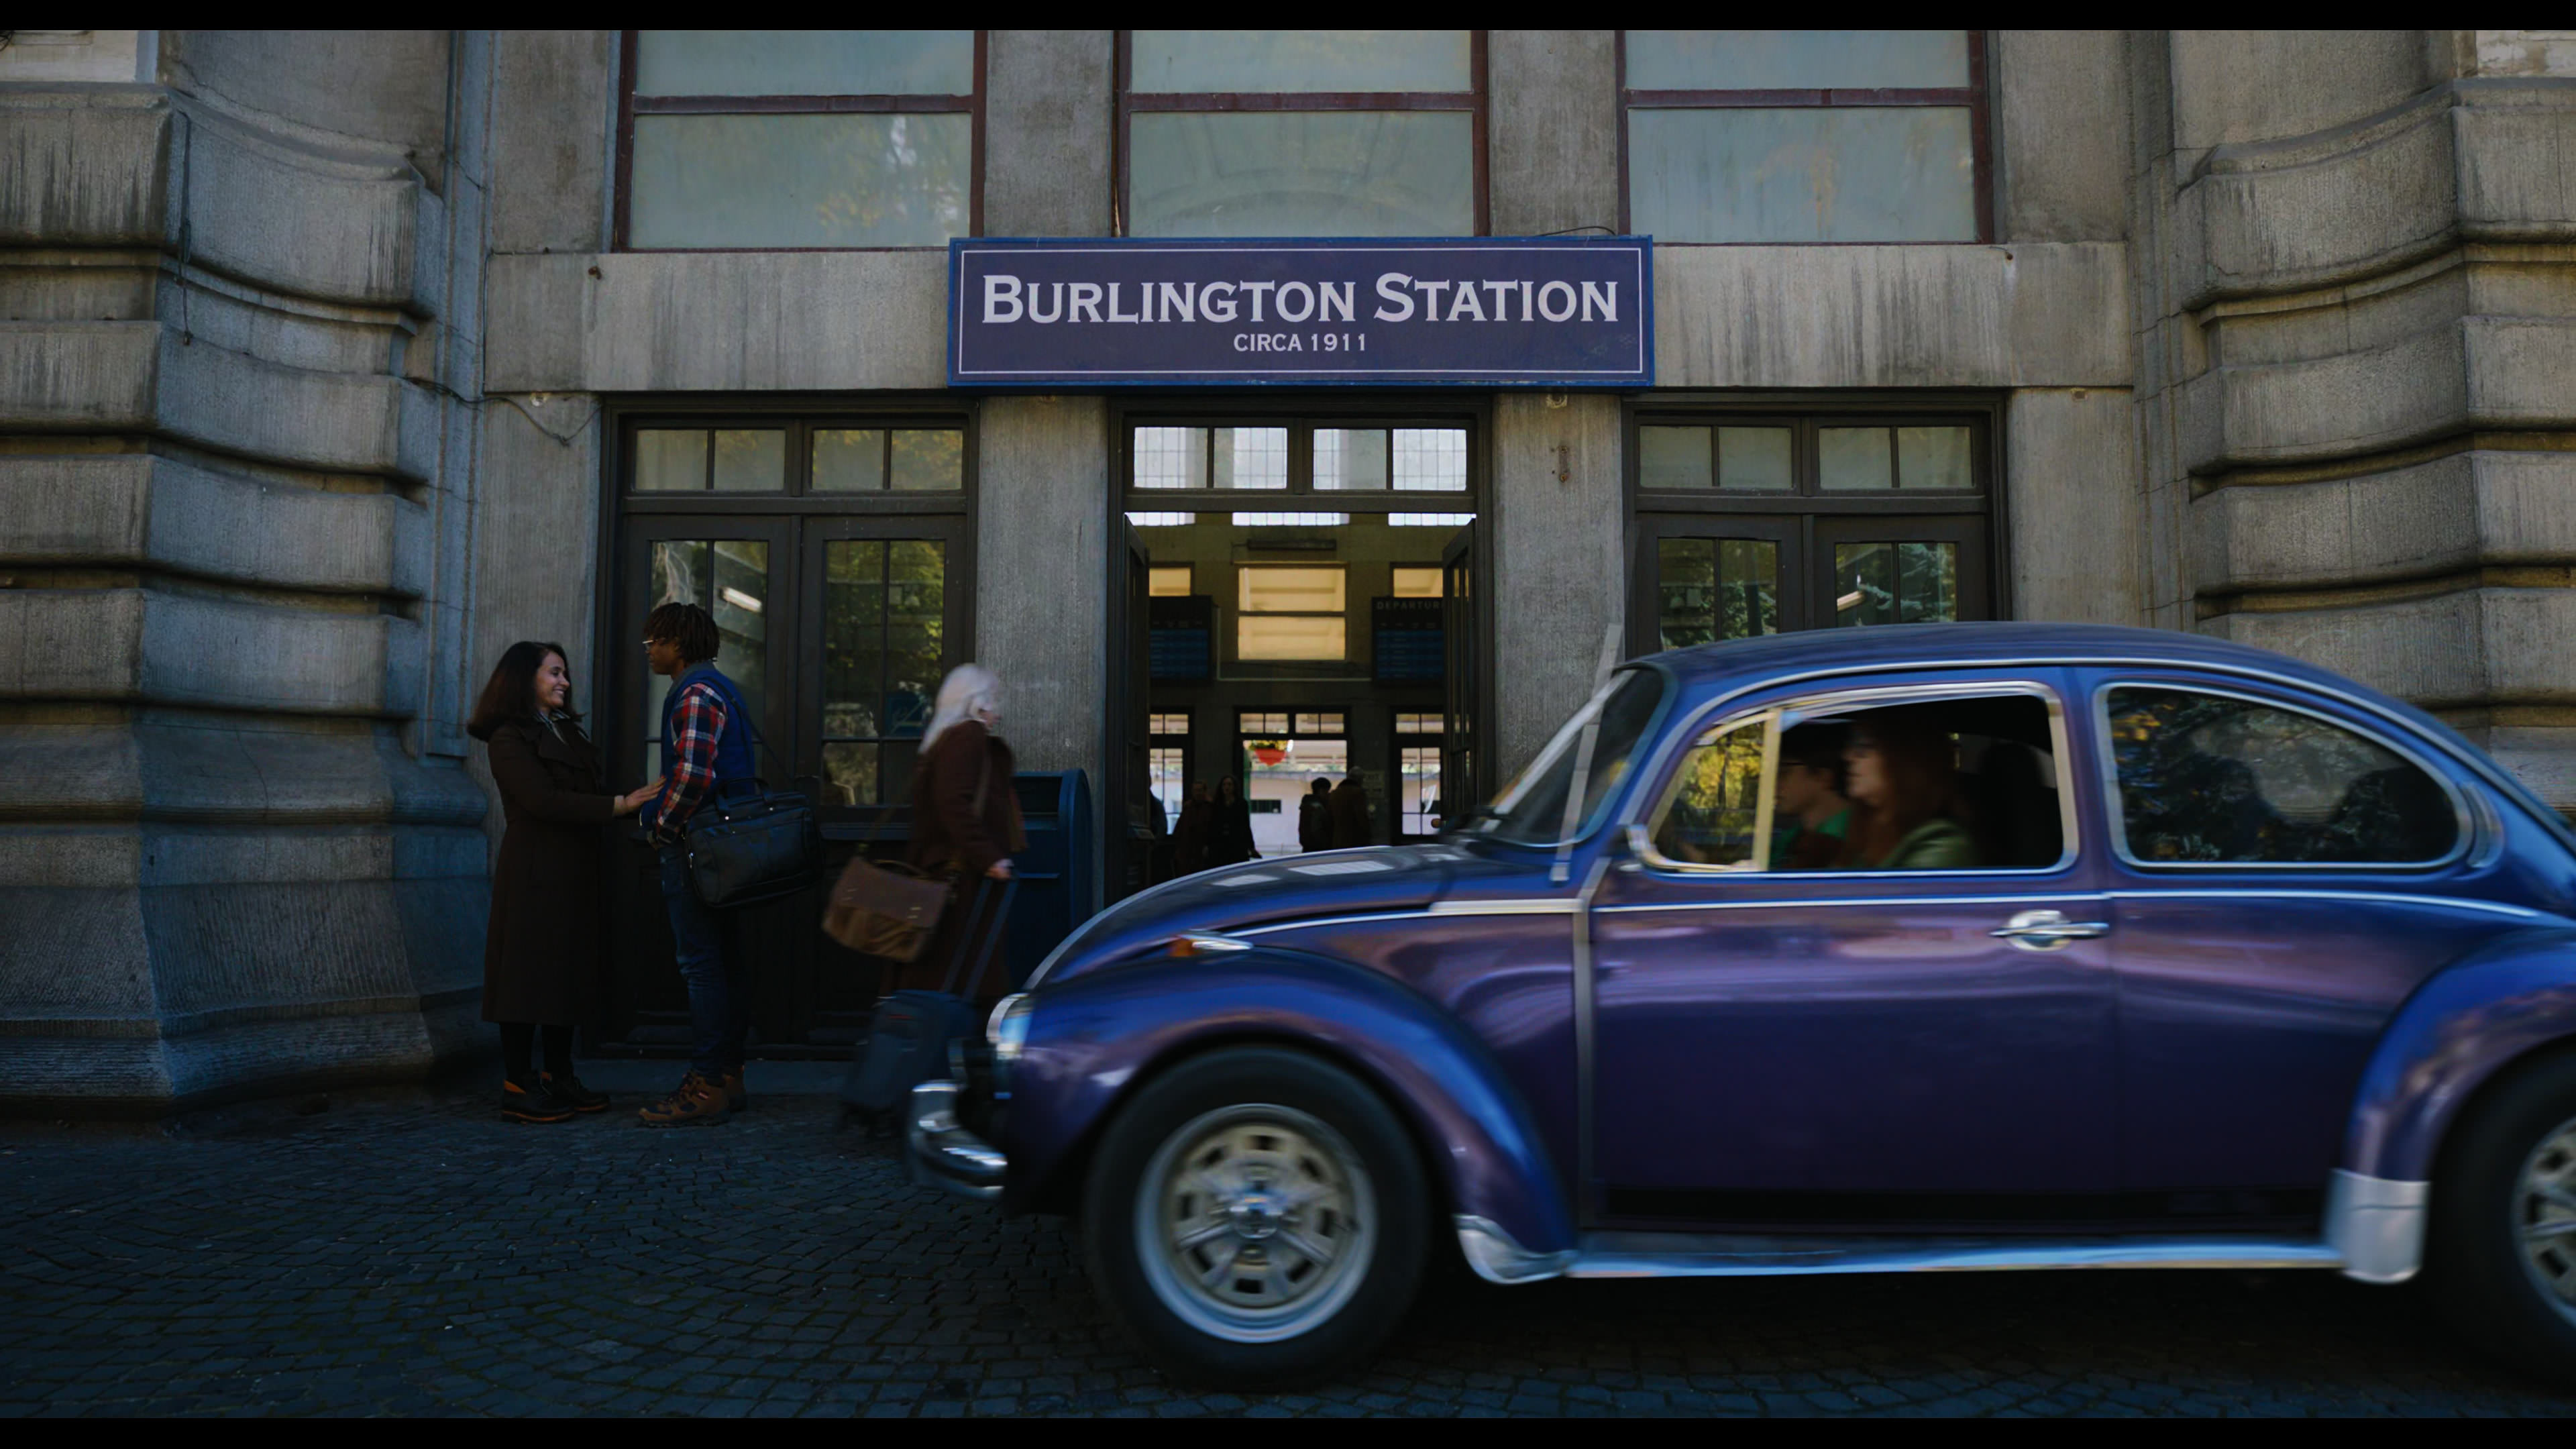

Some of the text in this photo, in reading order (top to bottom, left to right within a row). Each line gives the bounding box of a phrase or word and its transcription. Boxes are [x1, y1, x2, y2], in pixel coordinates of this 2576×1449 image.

[982, 272, 1618, 324] BURLINGTON STATION
[1233, 333, 1366, 352] CIRCA 1911
[1377, 600, 1442, 610] DEPARTUR
